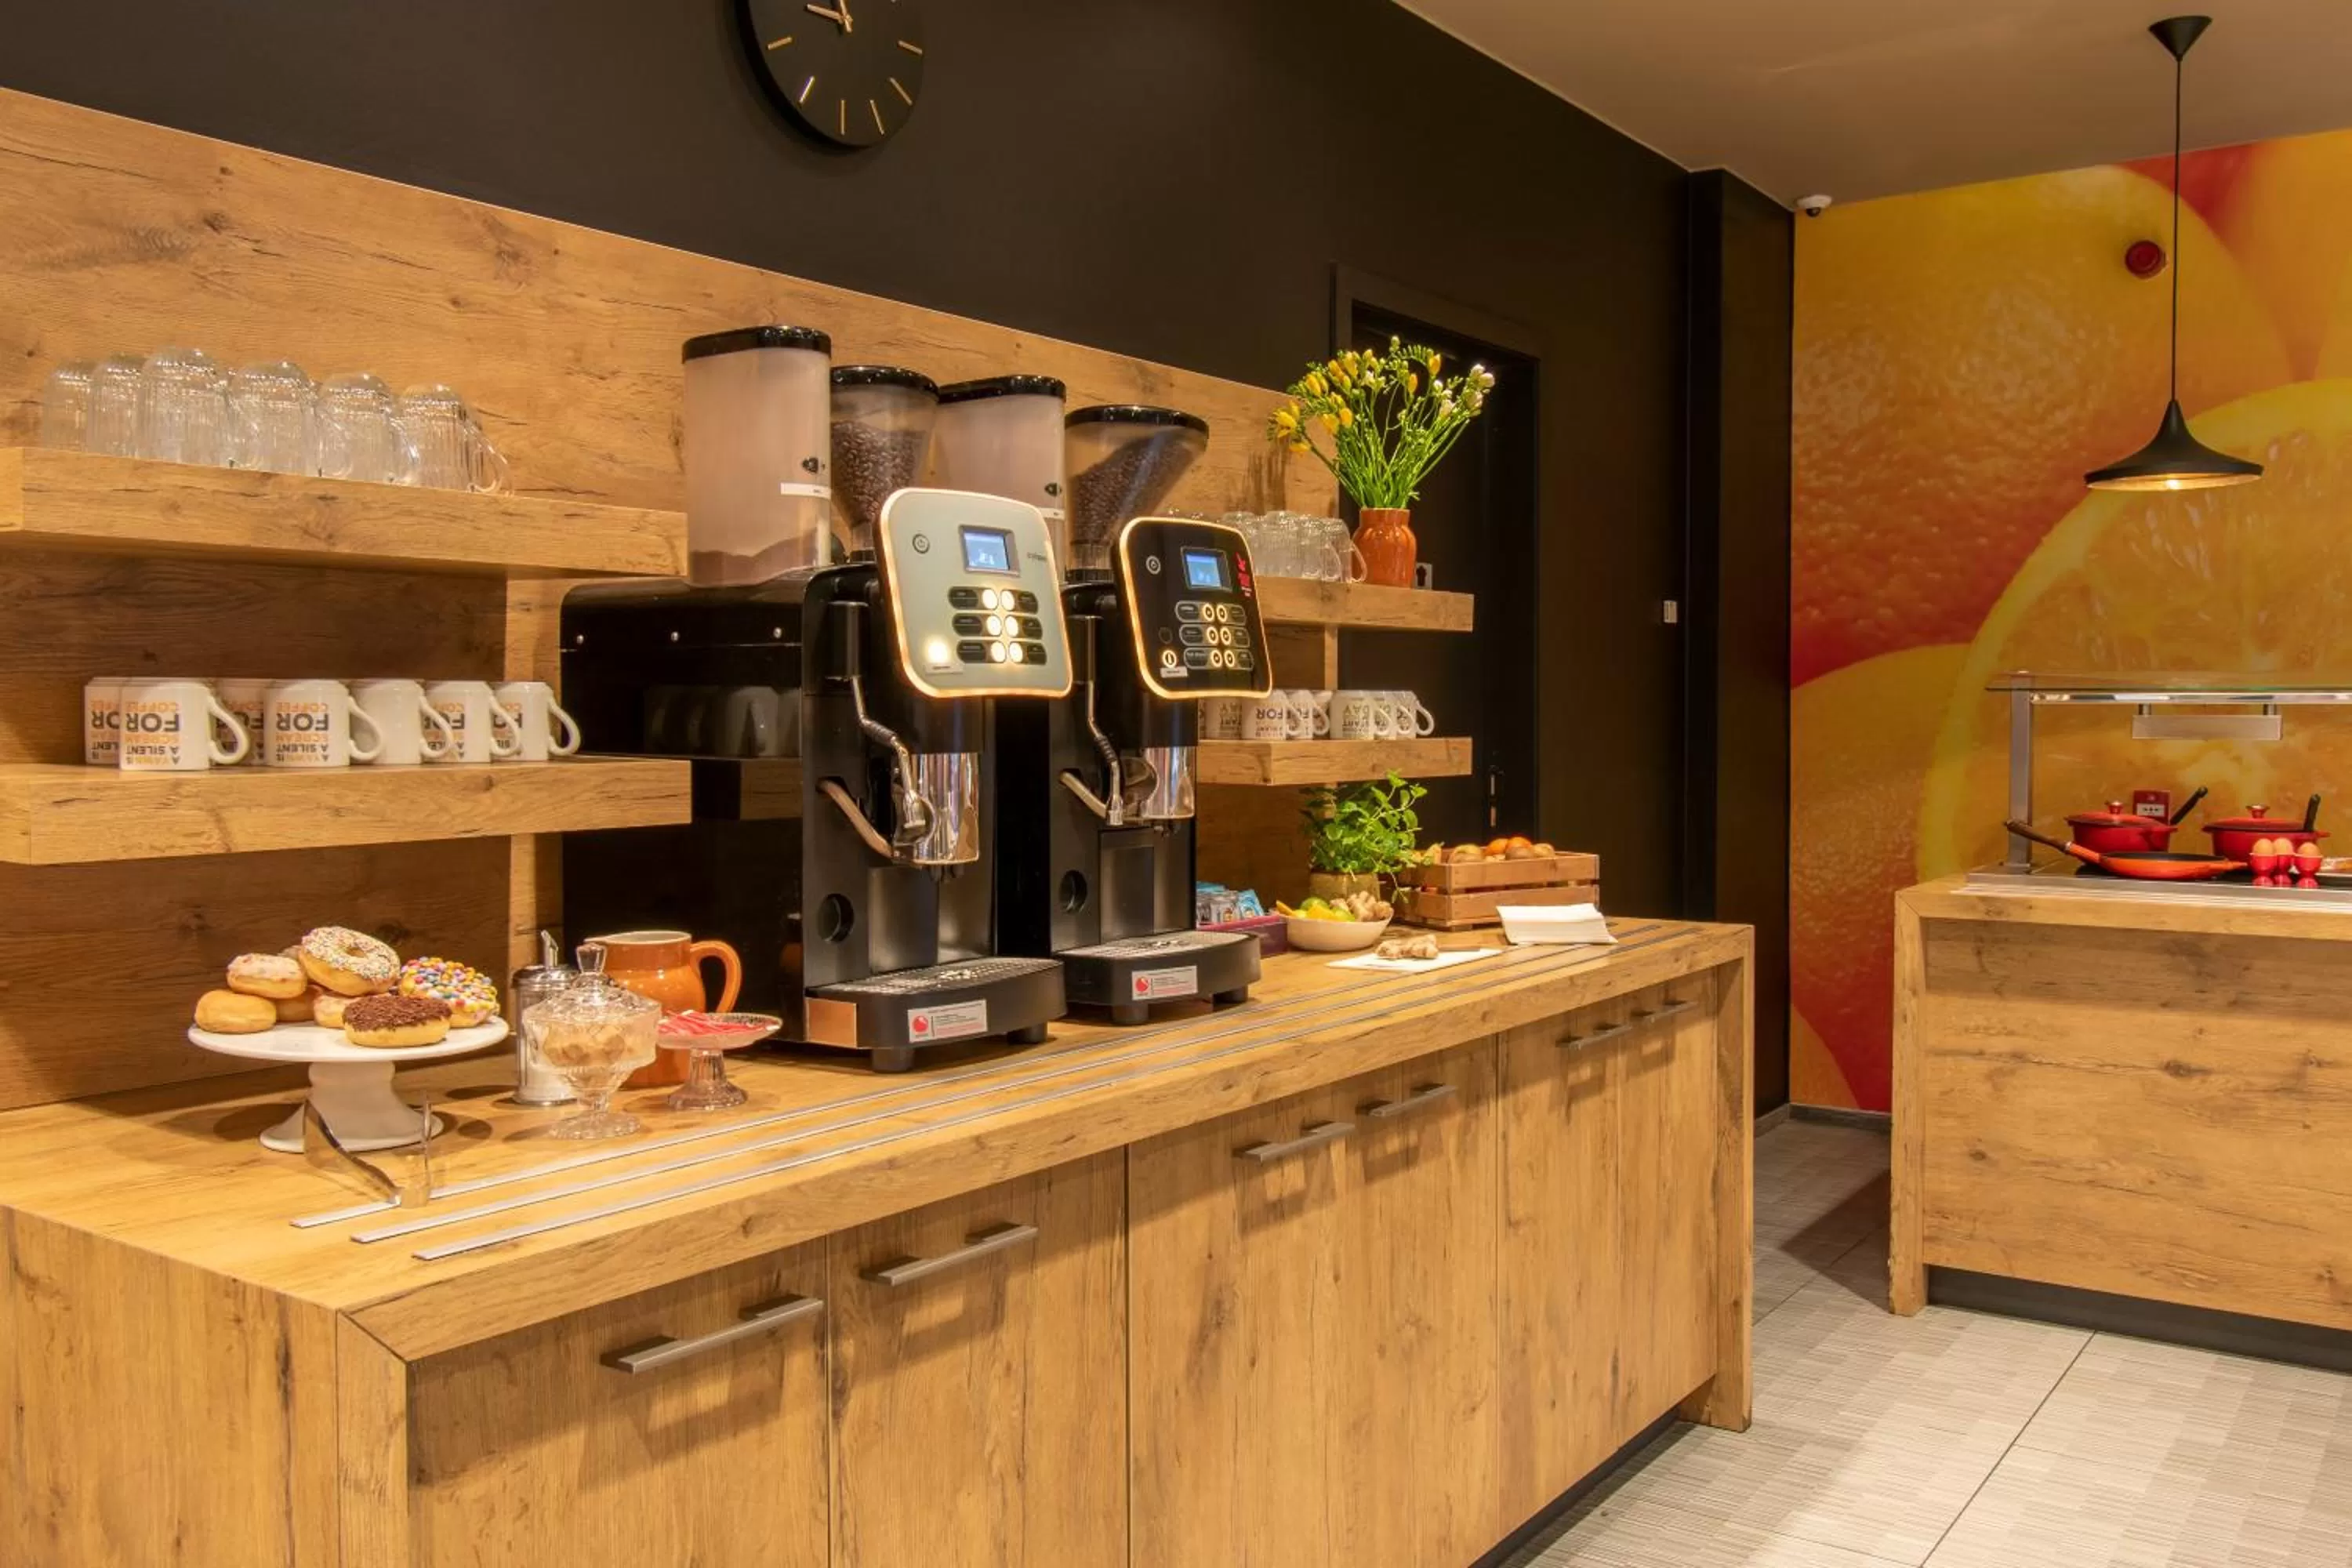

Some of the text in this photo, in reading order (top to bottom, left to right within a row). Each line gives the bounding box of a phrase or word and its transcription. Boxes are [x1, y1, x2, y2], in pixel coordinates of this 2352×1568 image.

[125, 702, 180, 713] COFFEE
[276, 702, 328, 712] COFFEE
[1342, 705, 1370, 716] DAY
[1256, 708, 1283, 720] FOR
[91, 711, 119, 729] OR
[125, 713, 180, 732] FOR
[276, 713, 329, 731] FOR
[275, 733, 329, 742] SCREAM
[91, 742, 119, 751] LENT
[125, 746, 180, 755] A SILENT
[276, 744, 328, 753] A SILENT
[172, 756, 180, 765] A
